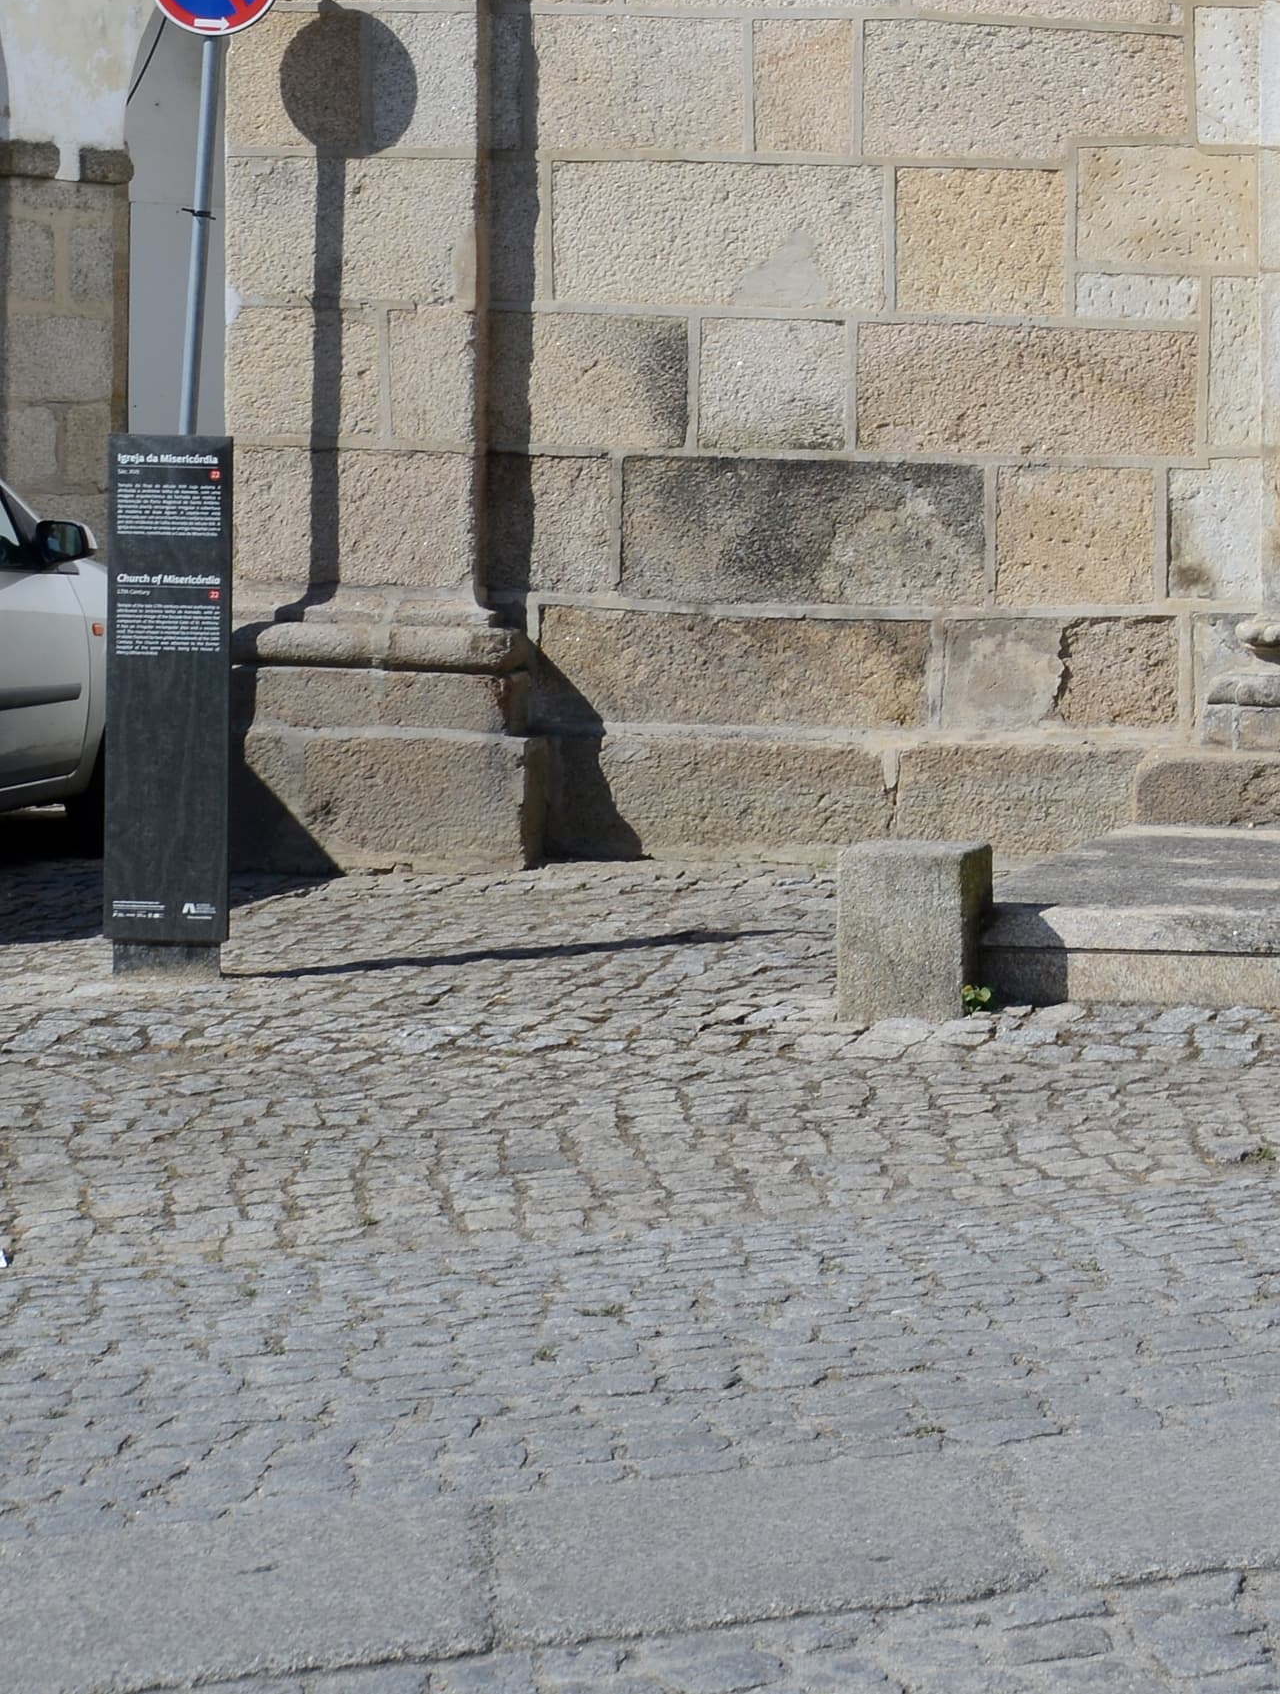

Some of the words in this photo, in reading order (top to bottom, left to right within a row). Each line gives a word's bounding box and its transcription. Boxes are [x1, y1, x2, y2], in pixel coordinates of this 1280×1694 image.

[117, 453, 145, 465] Igreja
[146, 454, 159, 463] da
[160, 454, 219, 465] Misericórdia
[116, 573, 150, 584] Church
[151, 574, 162, 586] of
[162, 575, 221, 585] Misericórdia
